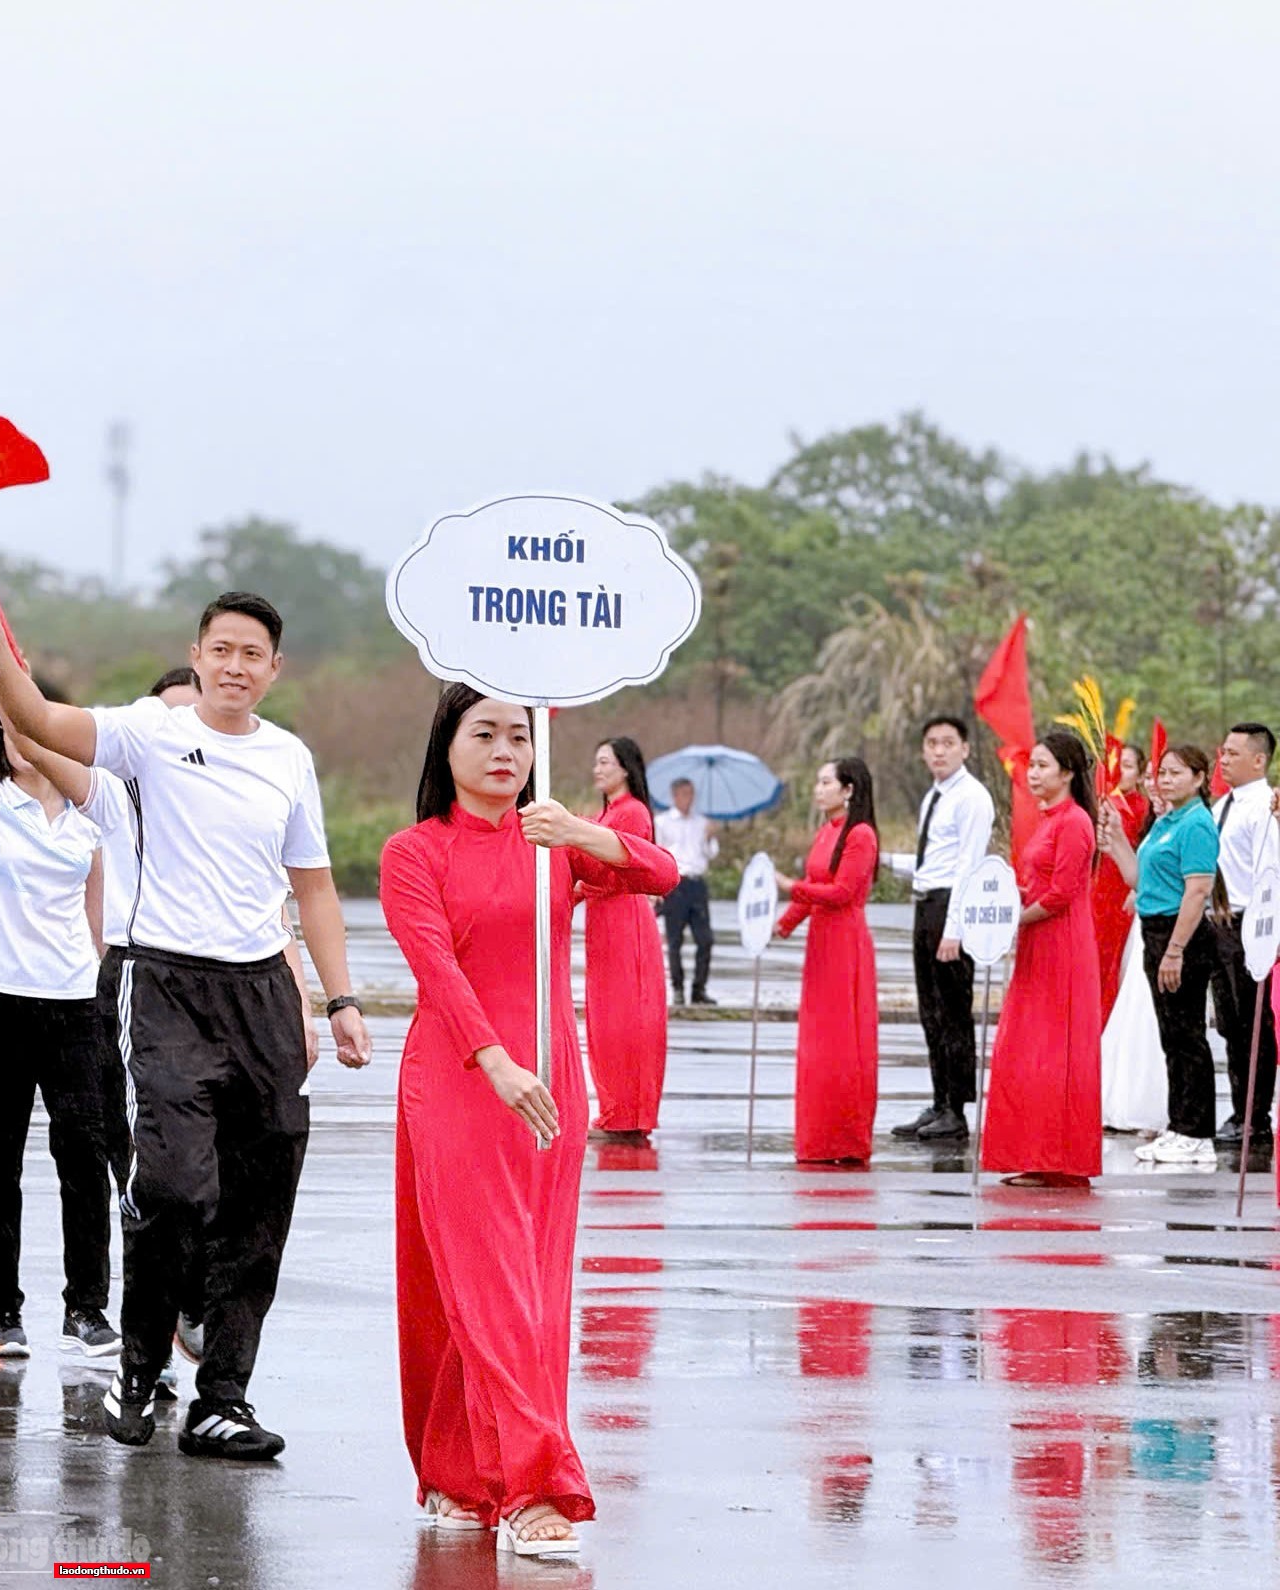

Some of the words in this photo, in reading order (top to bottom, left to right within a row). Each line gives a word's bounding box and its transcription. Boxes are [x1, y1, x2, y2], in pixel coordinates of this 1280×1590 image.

[507, 529, 585, 564] KHỐI
[468, 585, 567, 632] TRỌNG
[576, 584, 622, 629] TÀI
